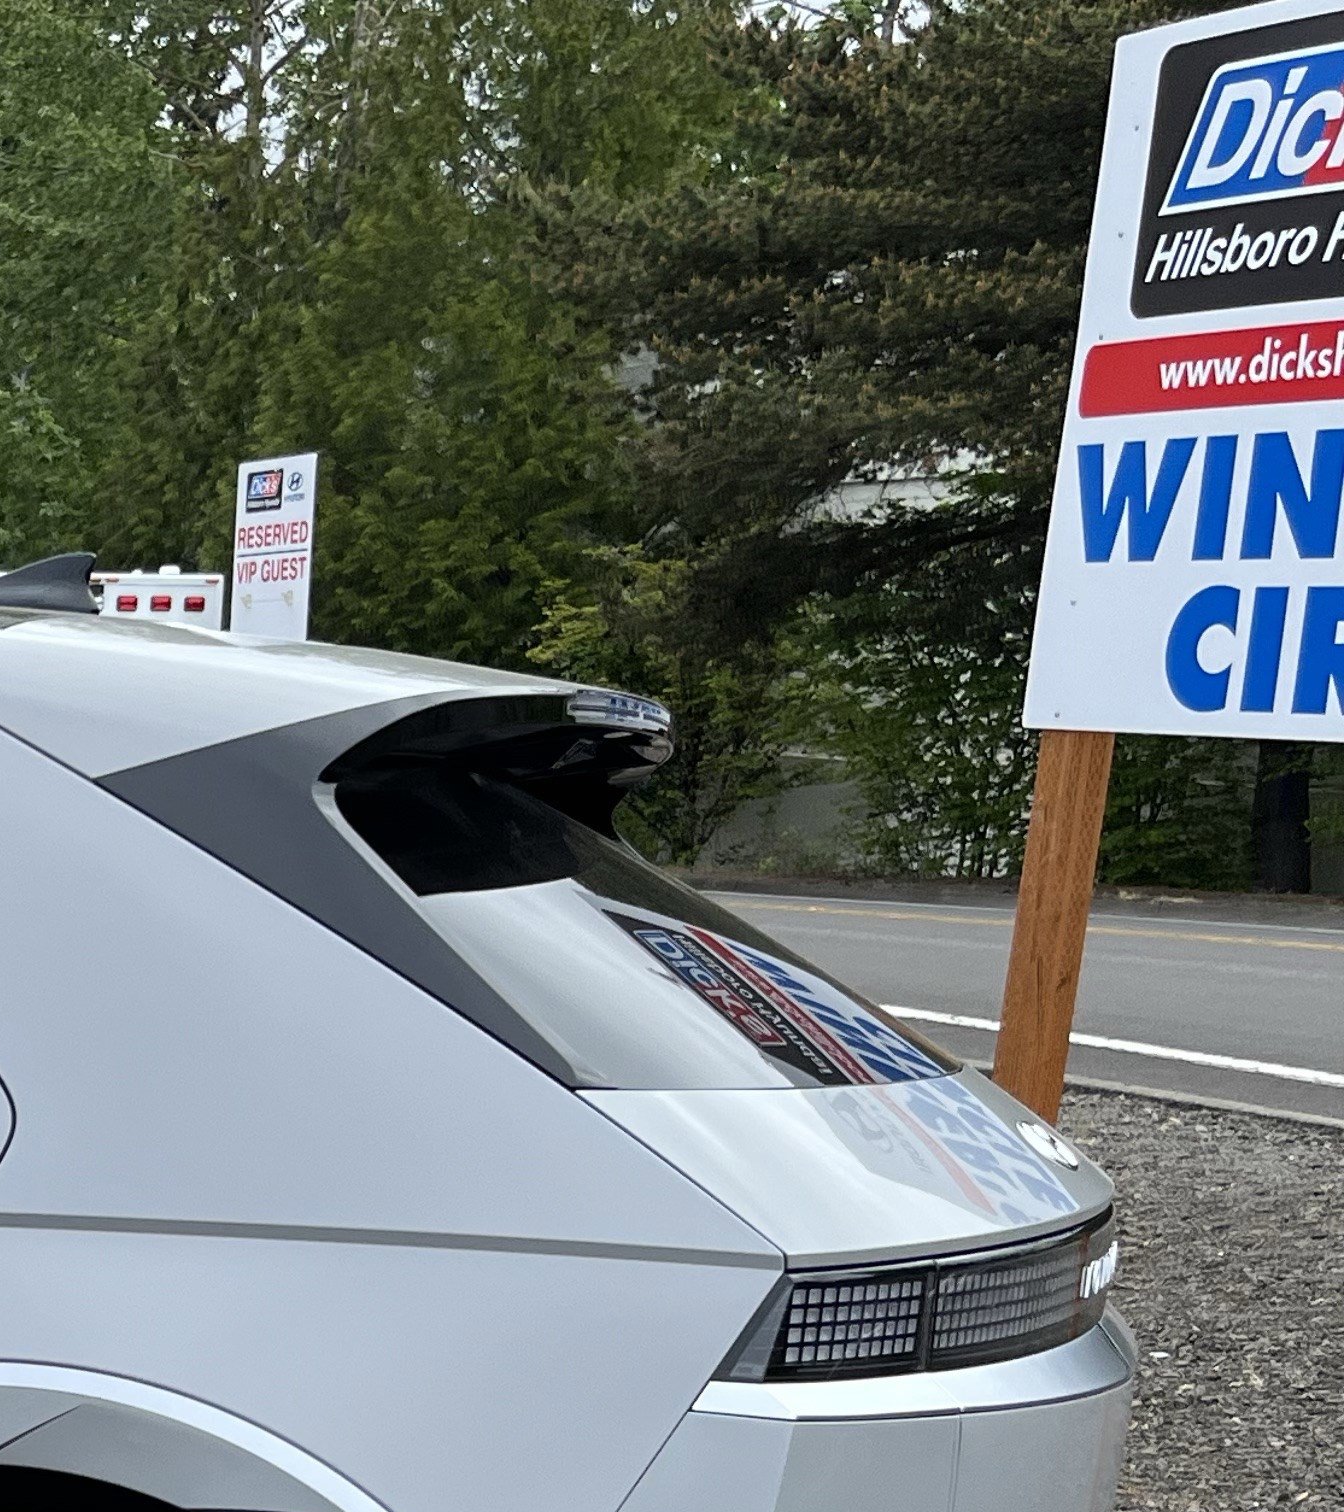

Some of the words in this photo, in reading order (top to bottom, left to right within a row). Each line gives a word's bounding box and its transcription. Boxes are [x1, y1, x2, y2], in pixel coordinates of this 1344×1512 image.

[1144, 223, 1318, 283] Hillsboro
[1077, 428, 1344, 563] WIN
[237, 520, 309, 550] RESERVED
[237, 560, 257, 584] VIP
[260, 556, 307, 582] GUEST
